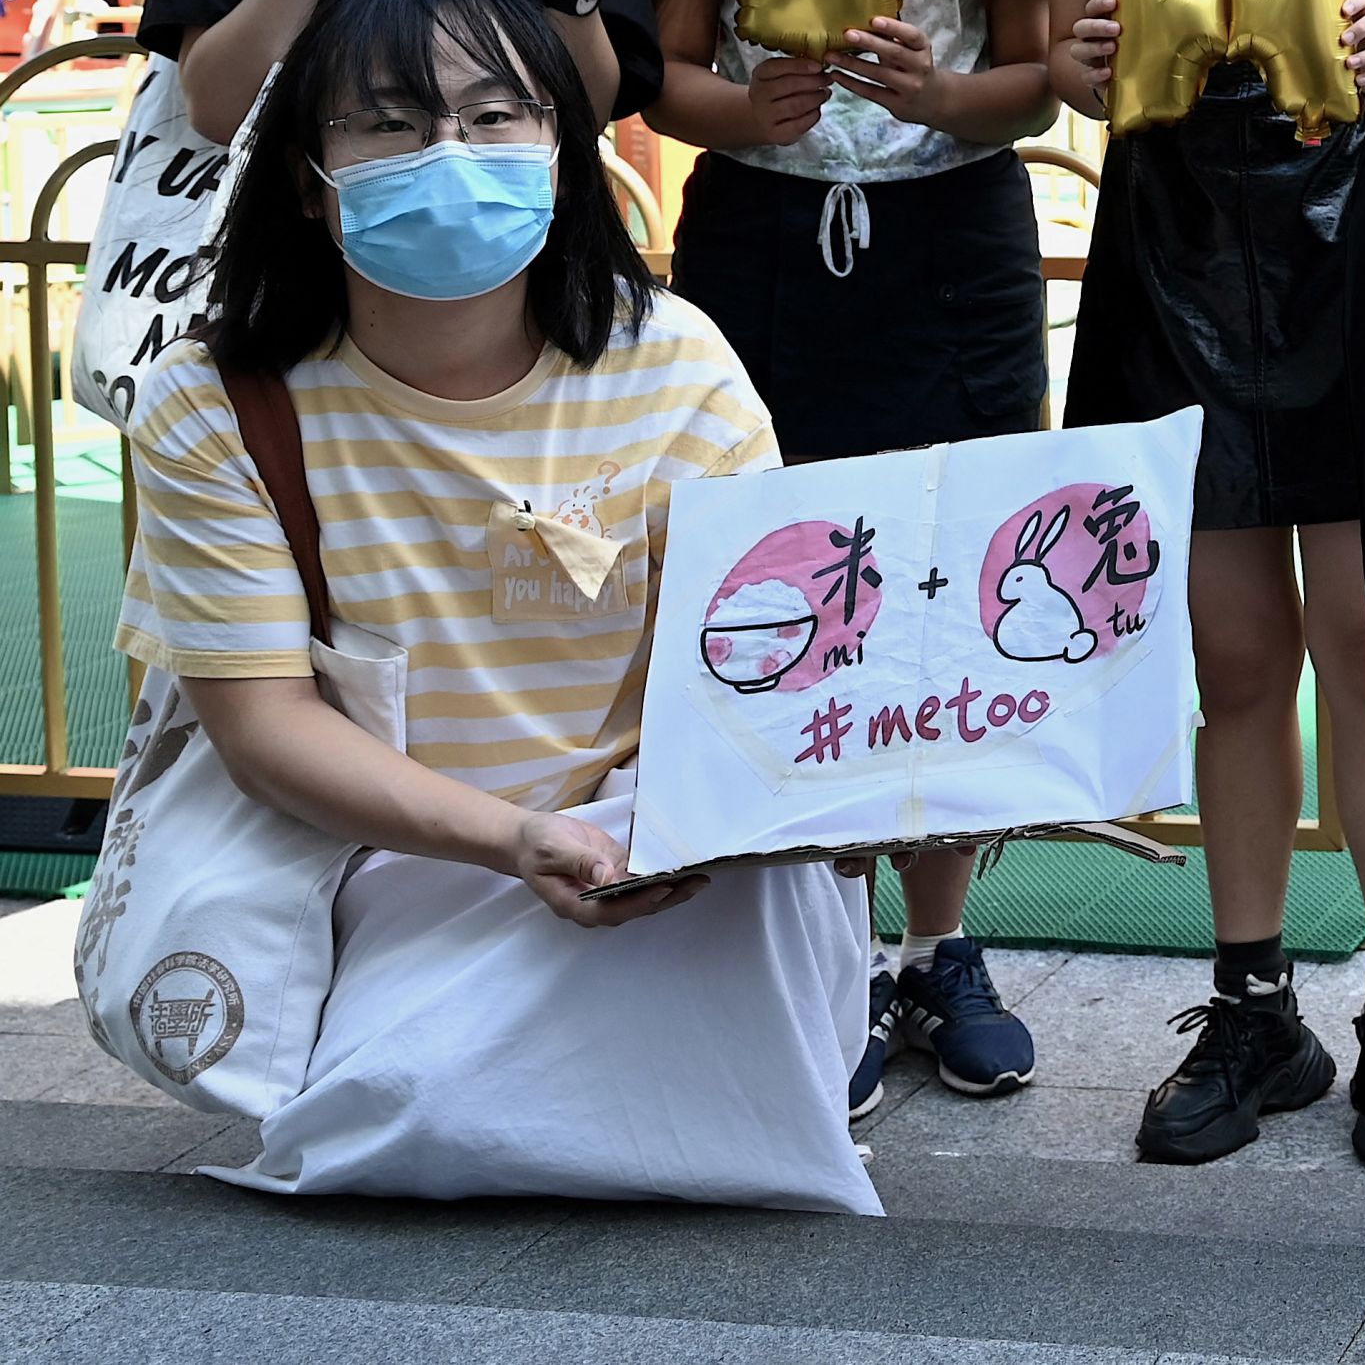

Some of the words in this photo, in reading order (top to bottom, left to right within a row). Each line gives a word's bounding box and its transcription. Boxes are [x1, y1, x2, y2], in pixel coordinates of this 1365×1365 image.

[812, 516, 883, 625] 米
[1082, 485, 1161, 592] 兔
[1105, 602, 1148, 639] tu
[822, 630, 867, 673] mi
